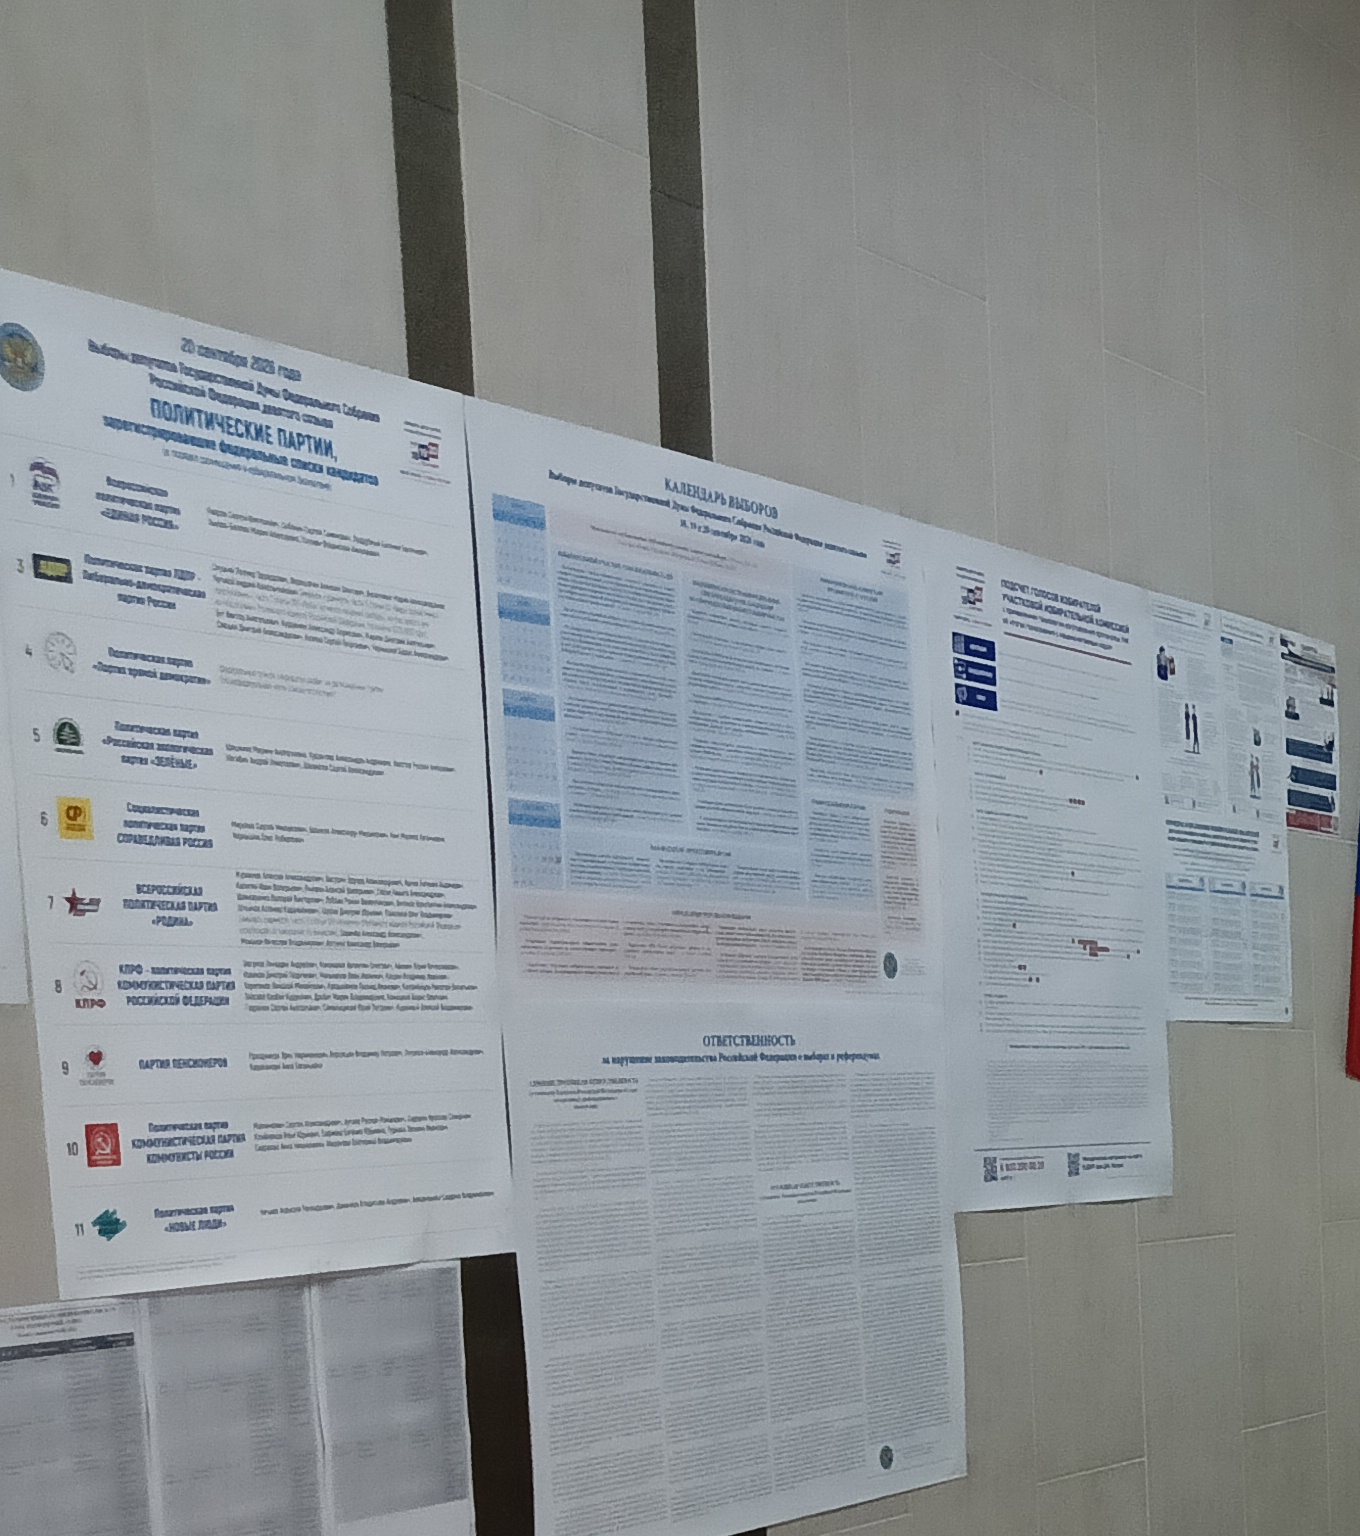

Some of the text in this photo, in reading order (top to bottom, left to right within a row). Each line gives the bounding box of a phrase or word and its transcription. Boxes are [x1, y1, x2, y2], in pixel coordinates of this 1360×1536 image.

[150, 397, 337, 463] ПОЛИТИЧЕСКИЕ ПАРТИИ,
[664, 477, 779, 520] КАЛЕНДАРЬ ВЫБОРОВ
[703, 1034, 796, 1047] ОТВЕТСТВЕННОСТЬ
[66, 1141, 78, 1156] 10
[74, 1223, 84, 1236] 11
